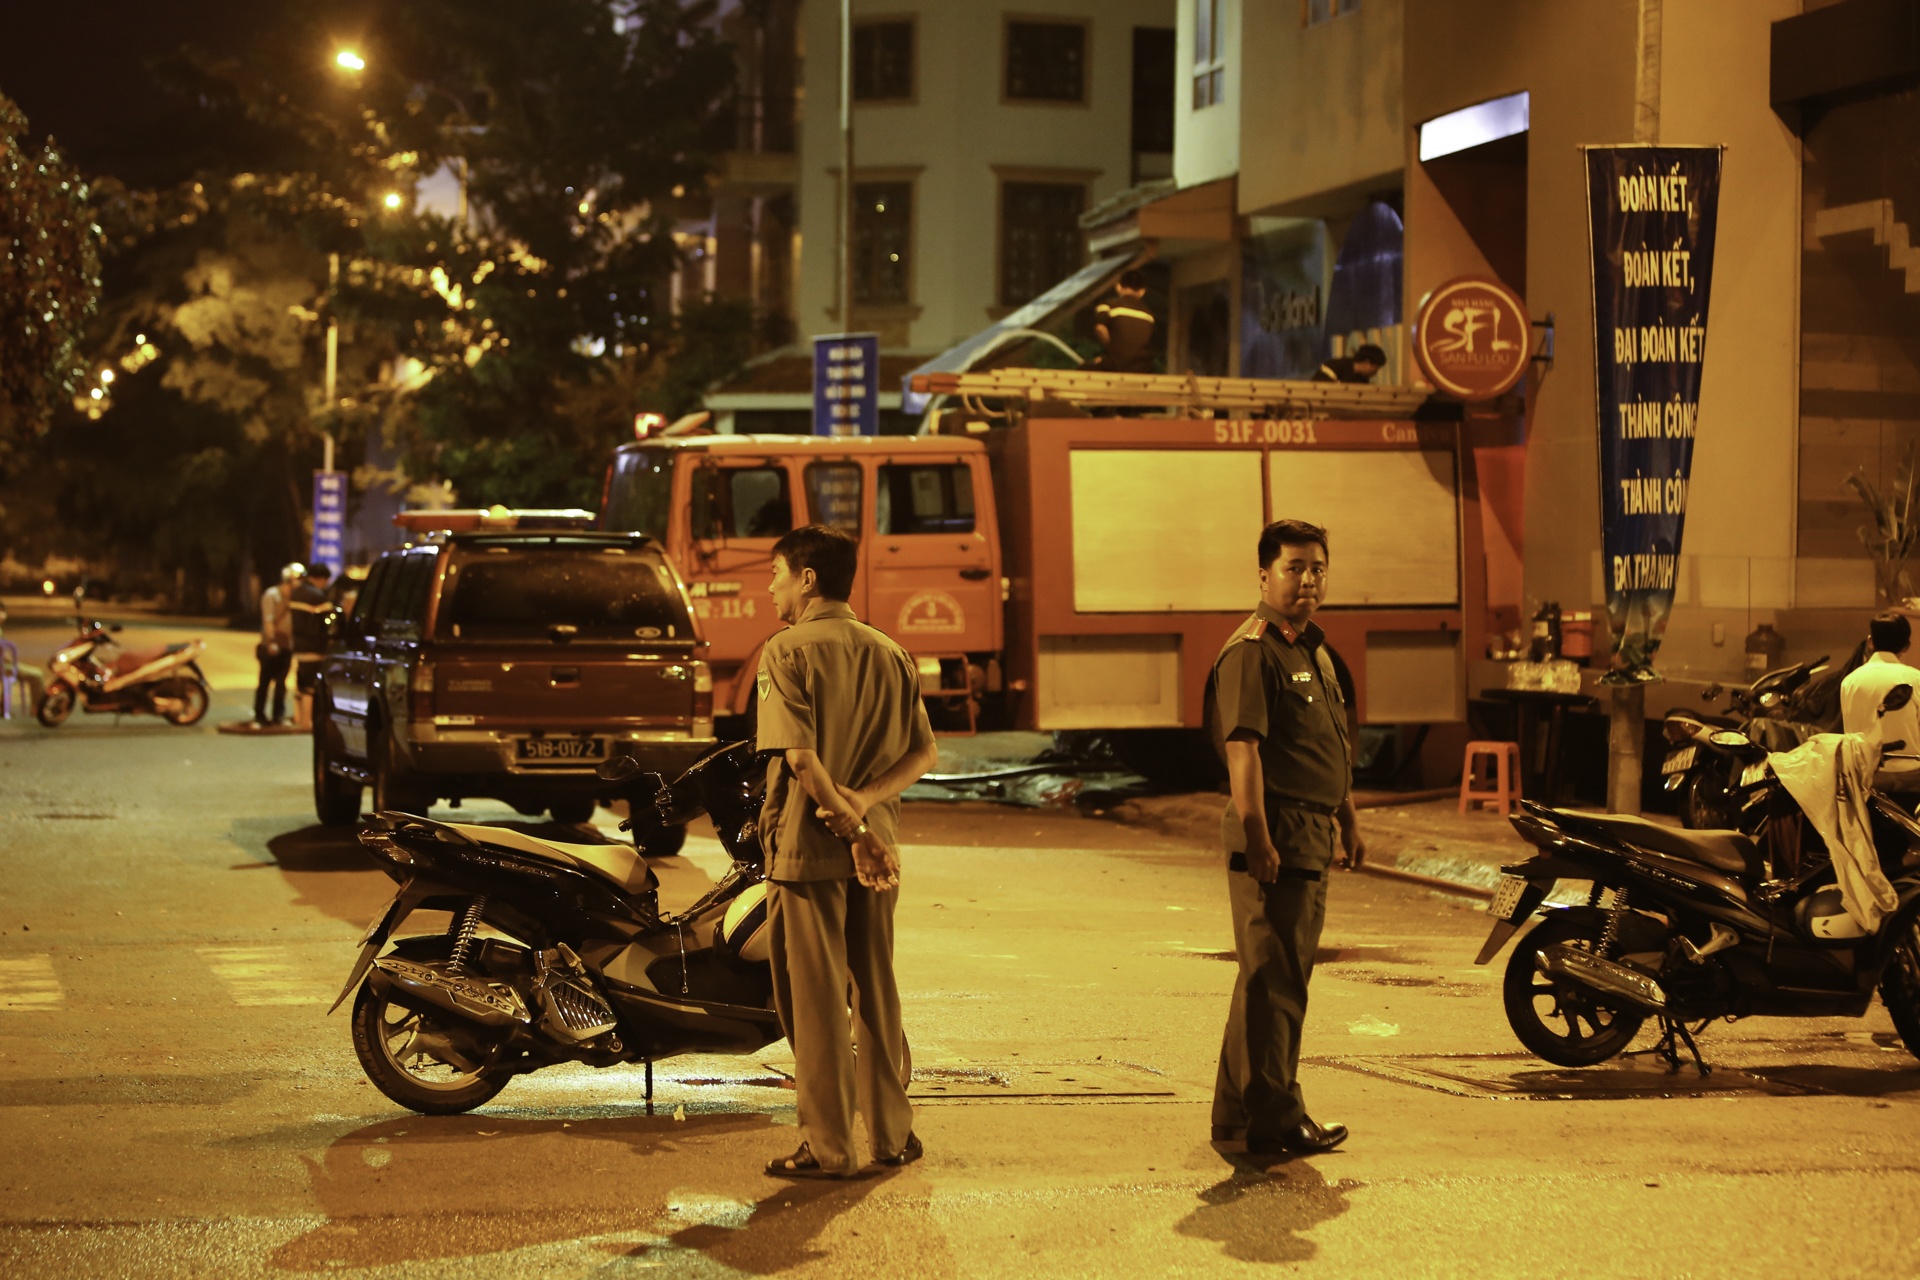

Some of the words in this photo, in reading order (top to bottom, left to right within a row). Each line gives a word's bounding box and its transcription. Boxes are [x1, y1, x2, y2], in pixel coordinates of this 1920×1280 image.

[1619, 165, 1658, 213] ĐOÀN
[1660, 161, 1693, 220] KẾT,
[1623, 241, 1660, 288] ĐOÀN
[1662, 237, 1695, 295] KẾT,
[1430, 307, 1520, 353] SFL
[1614, 327, 1638, 371] ĐẠI
[1640, 316, 1676, 363] ĐOÀN
[1679, 312, 1705, 363] KẾT
[1214, 420, 1317, 444] 51F.0031
[1619, 392, 1661, 440] THÀNH
[1664, 392, 1698, 440] CÔNG
[1621, 468, 1662, 515] THÀNH
[1634, 543, 1675, 590] THÀNH
